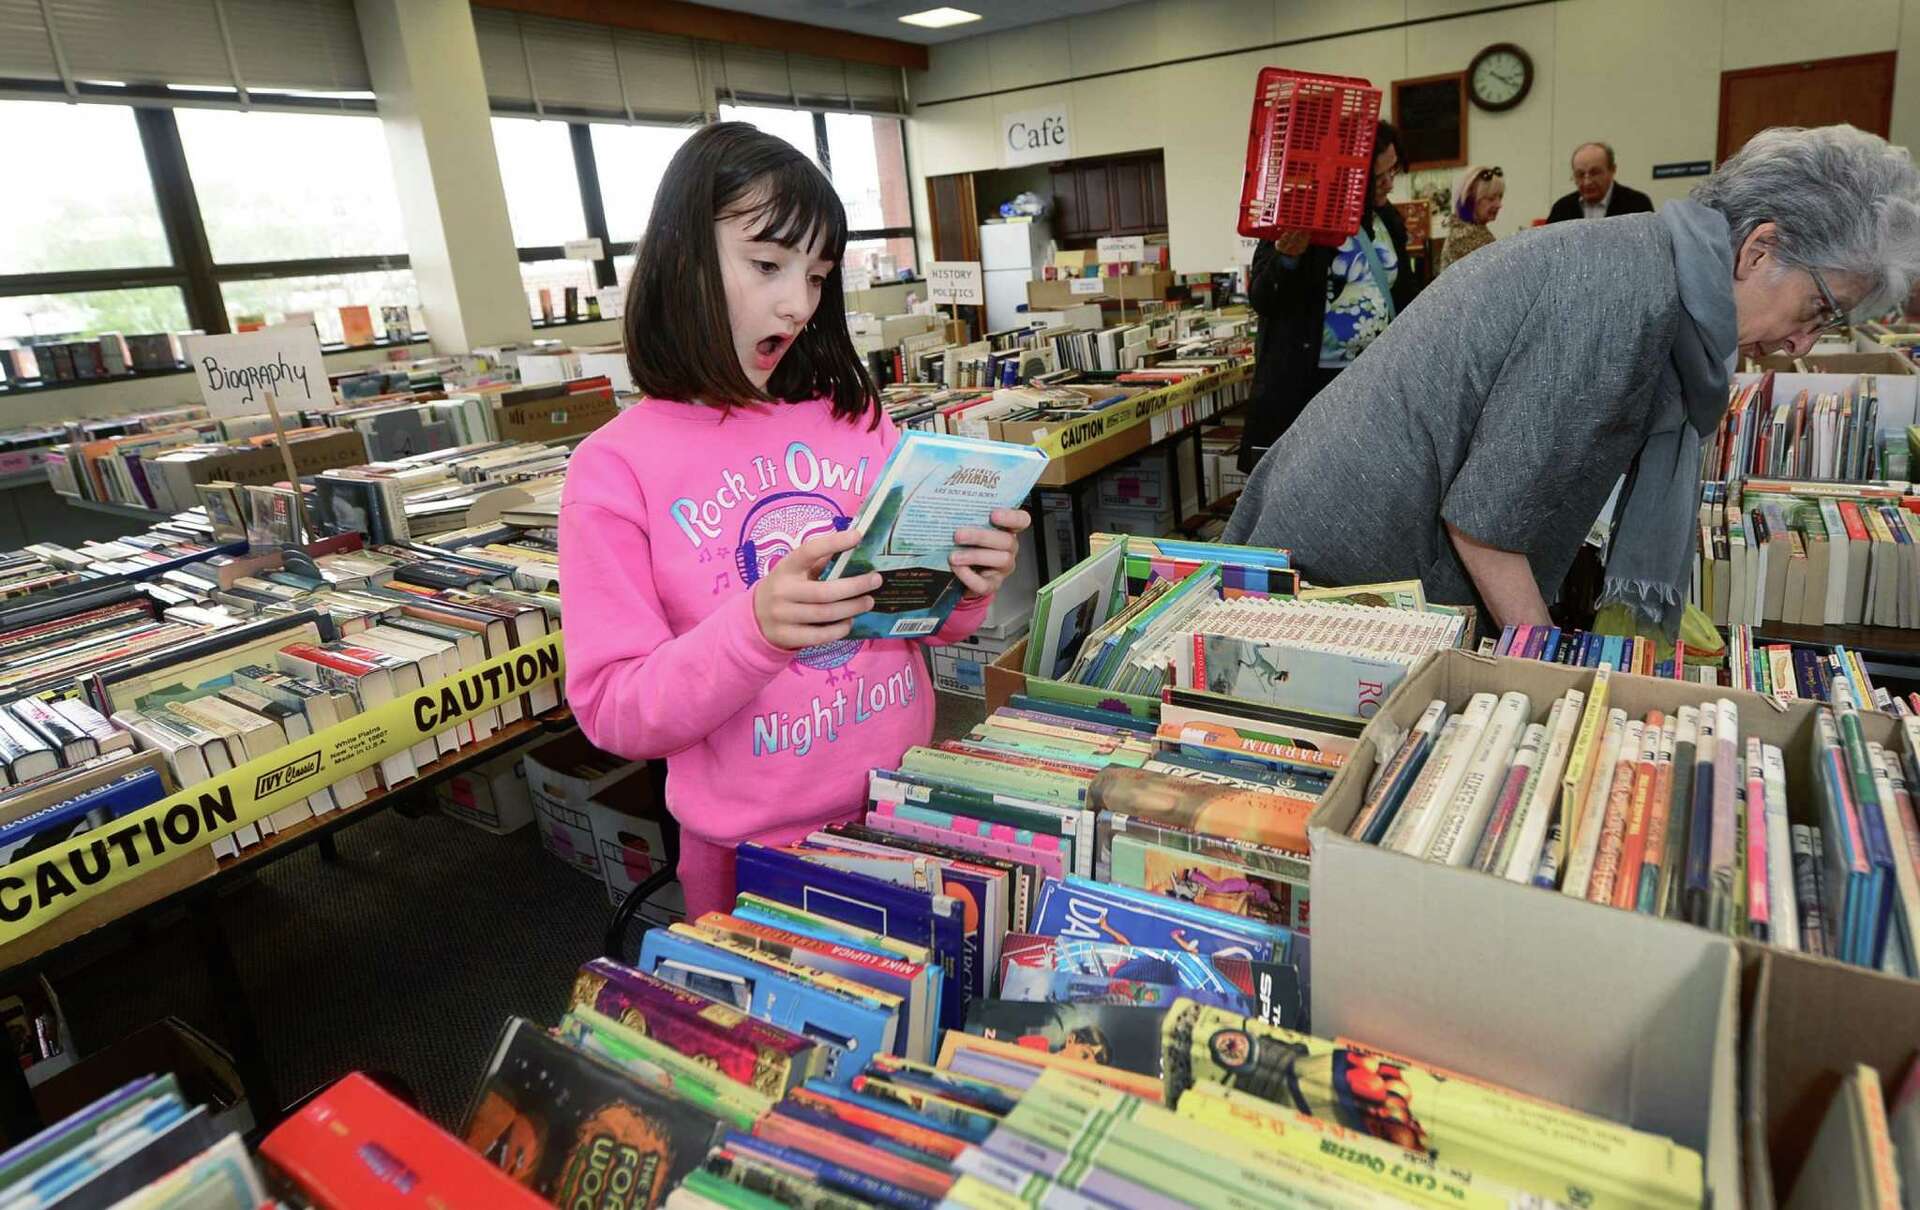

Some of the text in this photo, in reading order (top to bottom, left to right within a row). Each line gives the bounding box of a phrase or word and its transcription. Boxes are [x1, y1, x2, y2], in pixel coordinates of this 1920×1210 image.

[1008, 114, 1065, 152] Café
[932, 269, 973, 280] HISTORY
[932, 287, 975, 299] POLITICS
[1136, 393, 1168, 418] CAUTION
[1061, 417, 1104, 450] CAUTION
[669, 440, 868, 549] Rock It Owl
[413, 643, 560, 733] CAUTION
[752, 694, 848, 758] Night
[855, 663, 916, 723] Long
[331, 747, 349, 760] New
[348, 740, 366, 754] York
[335, 726, 381, 750] White Plains
[1241, 735, 1324, 765] BARNUM
[334, 752, 355, 765] Made
[356, 748, 364, 756] in
[260, 761, 316, 795] IVY Classic
[1, 783, 113, 832] BARBARA BUSH
[0, 785, 238, 923] CAUTION
[829, 943, 916, 975] MIKE LUPICA
[639, 1155, 658, 1185] THE
[1318, 1138, 1387, 1174] QUIZZER
